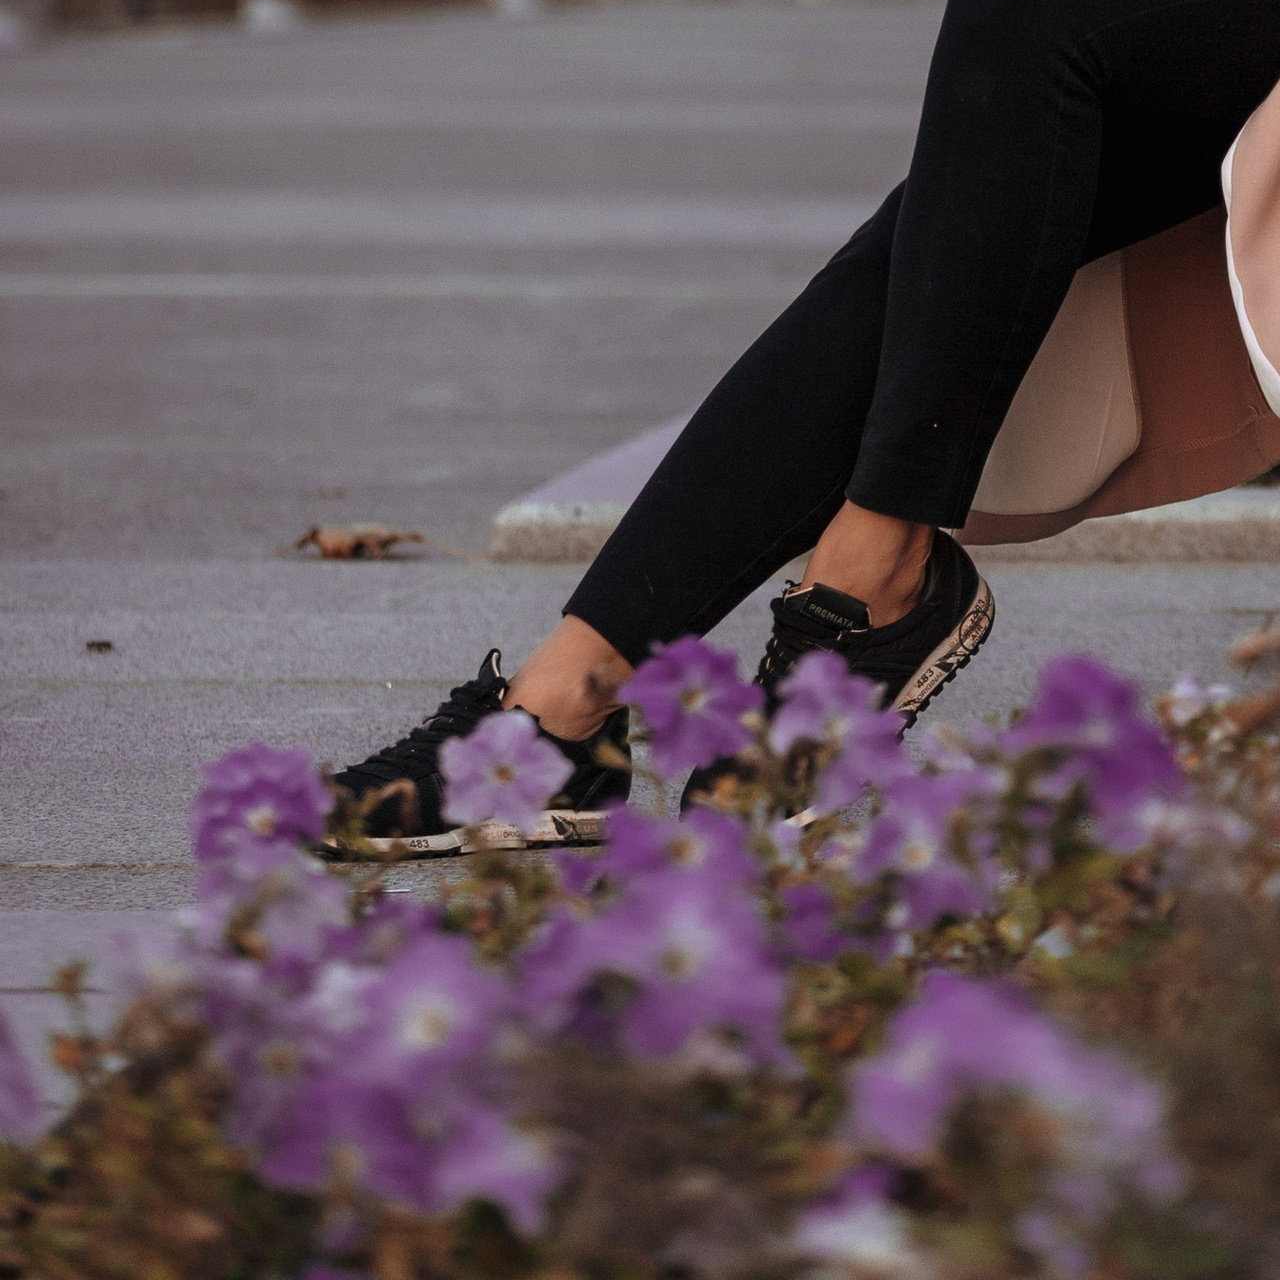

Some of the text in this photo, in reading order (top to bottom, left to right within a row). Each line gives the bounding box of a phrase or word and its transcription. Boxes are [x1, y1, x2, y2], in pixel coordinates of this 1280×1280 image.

[809, 603, 854, 629] PREMIATA
[915, 667, 935, 689] 483
[409, 839, 430, 849] 483
